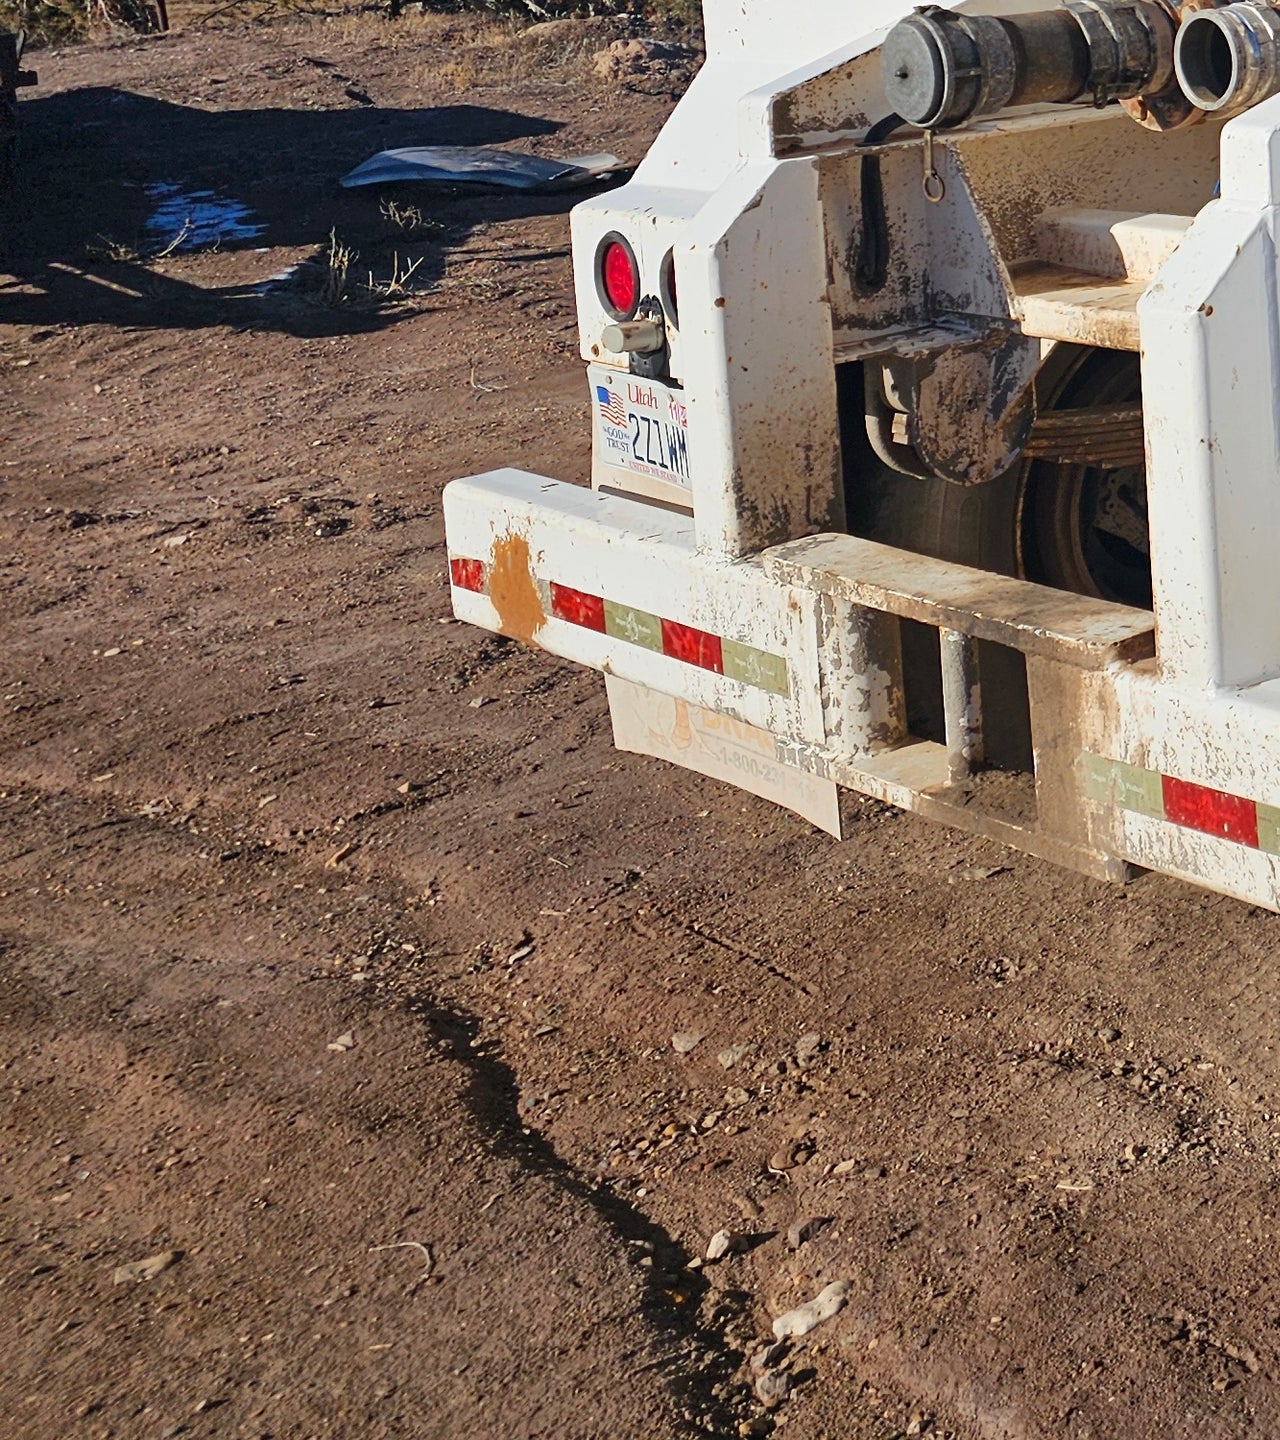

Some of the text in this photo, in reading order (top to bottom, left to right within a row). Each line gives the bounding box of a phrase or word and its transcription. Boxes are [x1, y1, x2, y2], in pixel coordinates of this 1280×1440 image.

[627, 383, 659, 409] Utah
[607, 426, 624, 440] GOD
[606, 437, 629, 453] TRUST
[629, 461, 650, 473] UNITED
